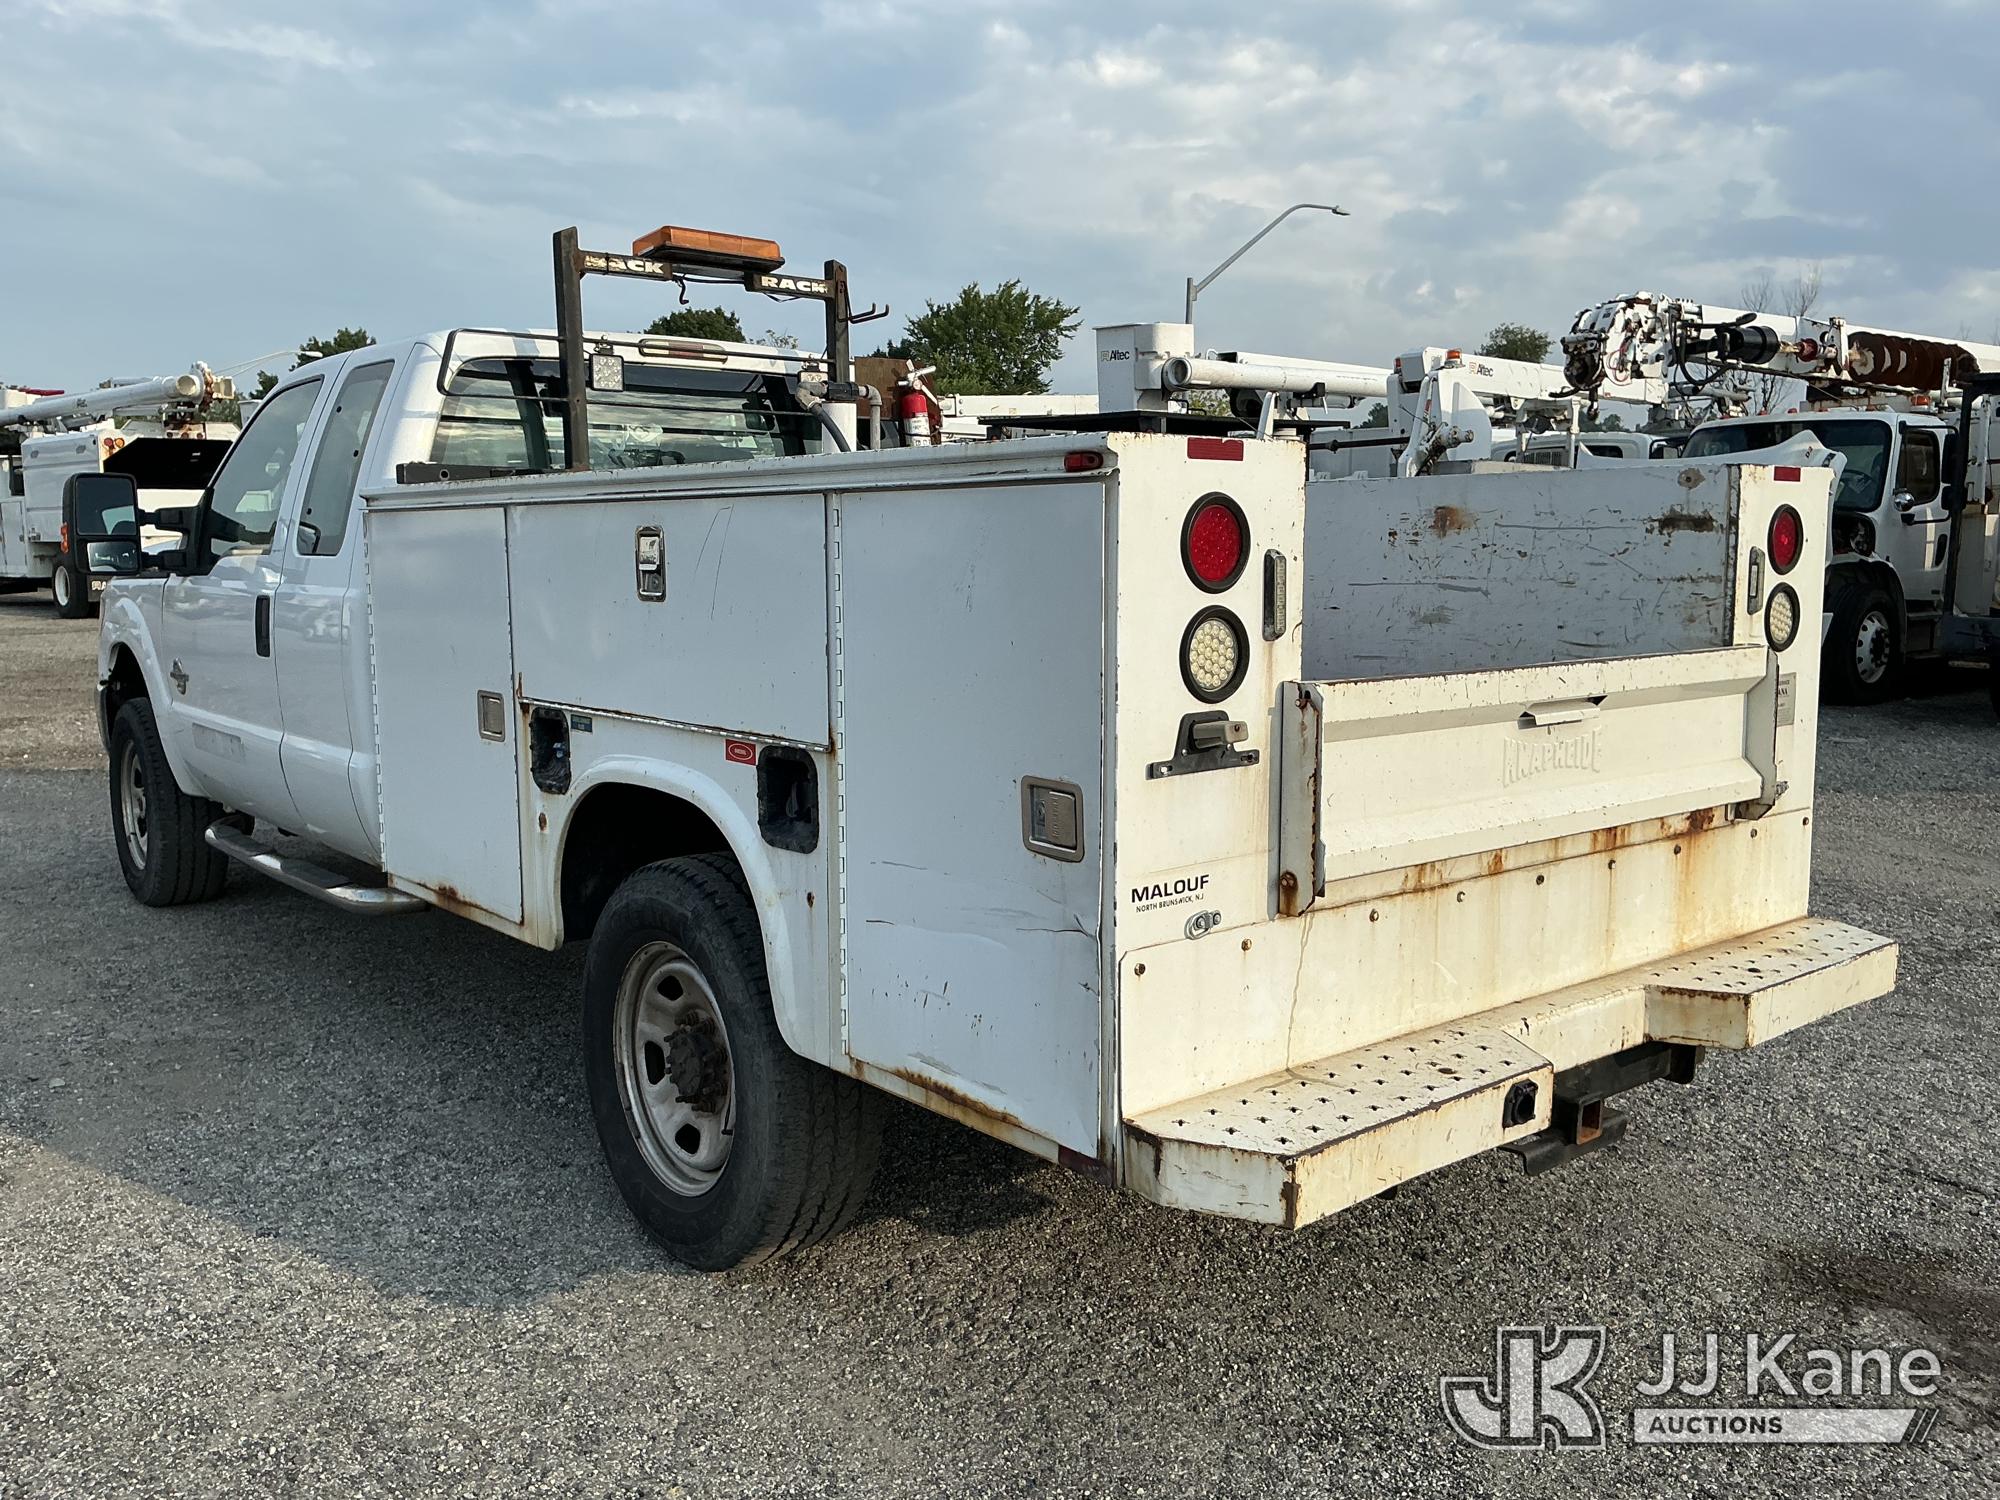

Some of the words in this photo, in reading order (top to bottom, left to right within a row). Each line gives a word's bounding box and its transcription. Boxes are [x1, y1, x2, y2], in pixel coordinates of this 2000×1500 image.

[761, 276, 828, 294] RACK
[1110, 349, 1130, 361] Altec
[1476, 363, 1494, 377] Altec
[1131, 874, 1210, 903] MALOUF
[1136, 902, 1158, 913] NORTH
